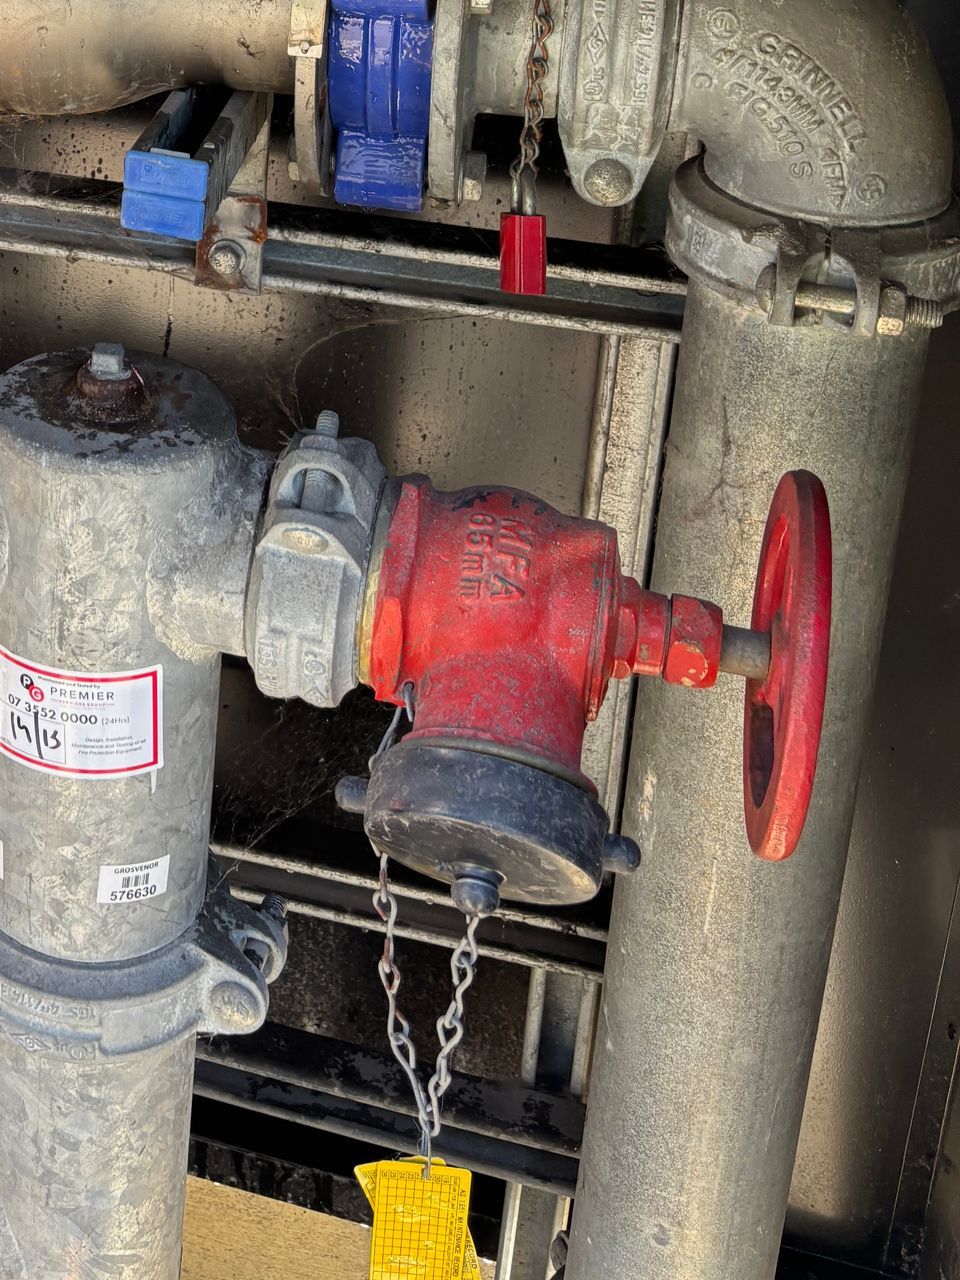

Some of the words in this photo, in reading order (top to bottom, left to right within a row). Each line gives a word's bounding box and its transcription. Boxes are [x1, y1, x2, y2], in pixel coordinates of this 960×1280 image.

[756, 32, 867, 158] GRINNELL
[490, 518, 533, 601] MFA
[50, 686, 115, 701] PREMIER
[8, 693, 21, 707] 07
[24, 701, 57, 721] 3552
[60, 712, 98, 725] 0000
[114, 861, 159, 875] GROSVENOR
[110, 884, 157, 902] 576630
